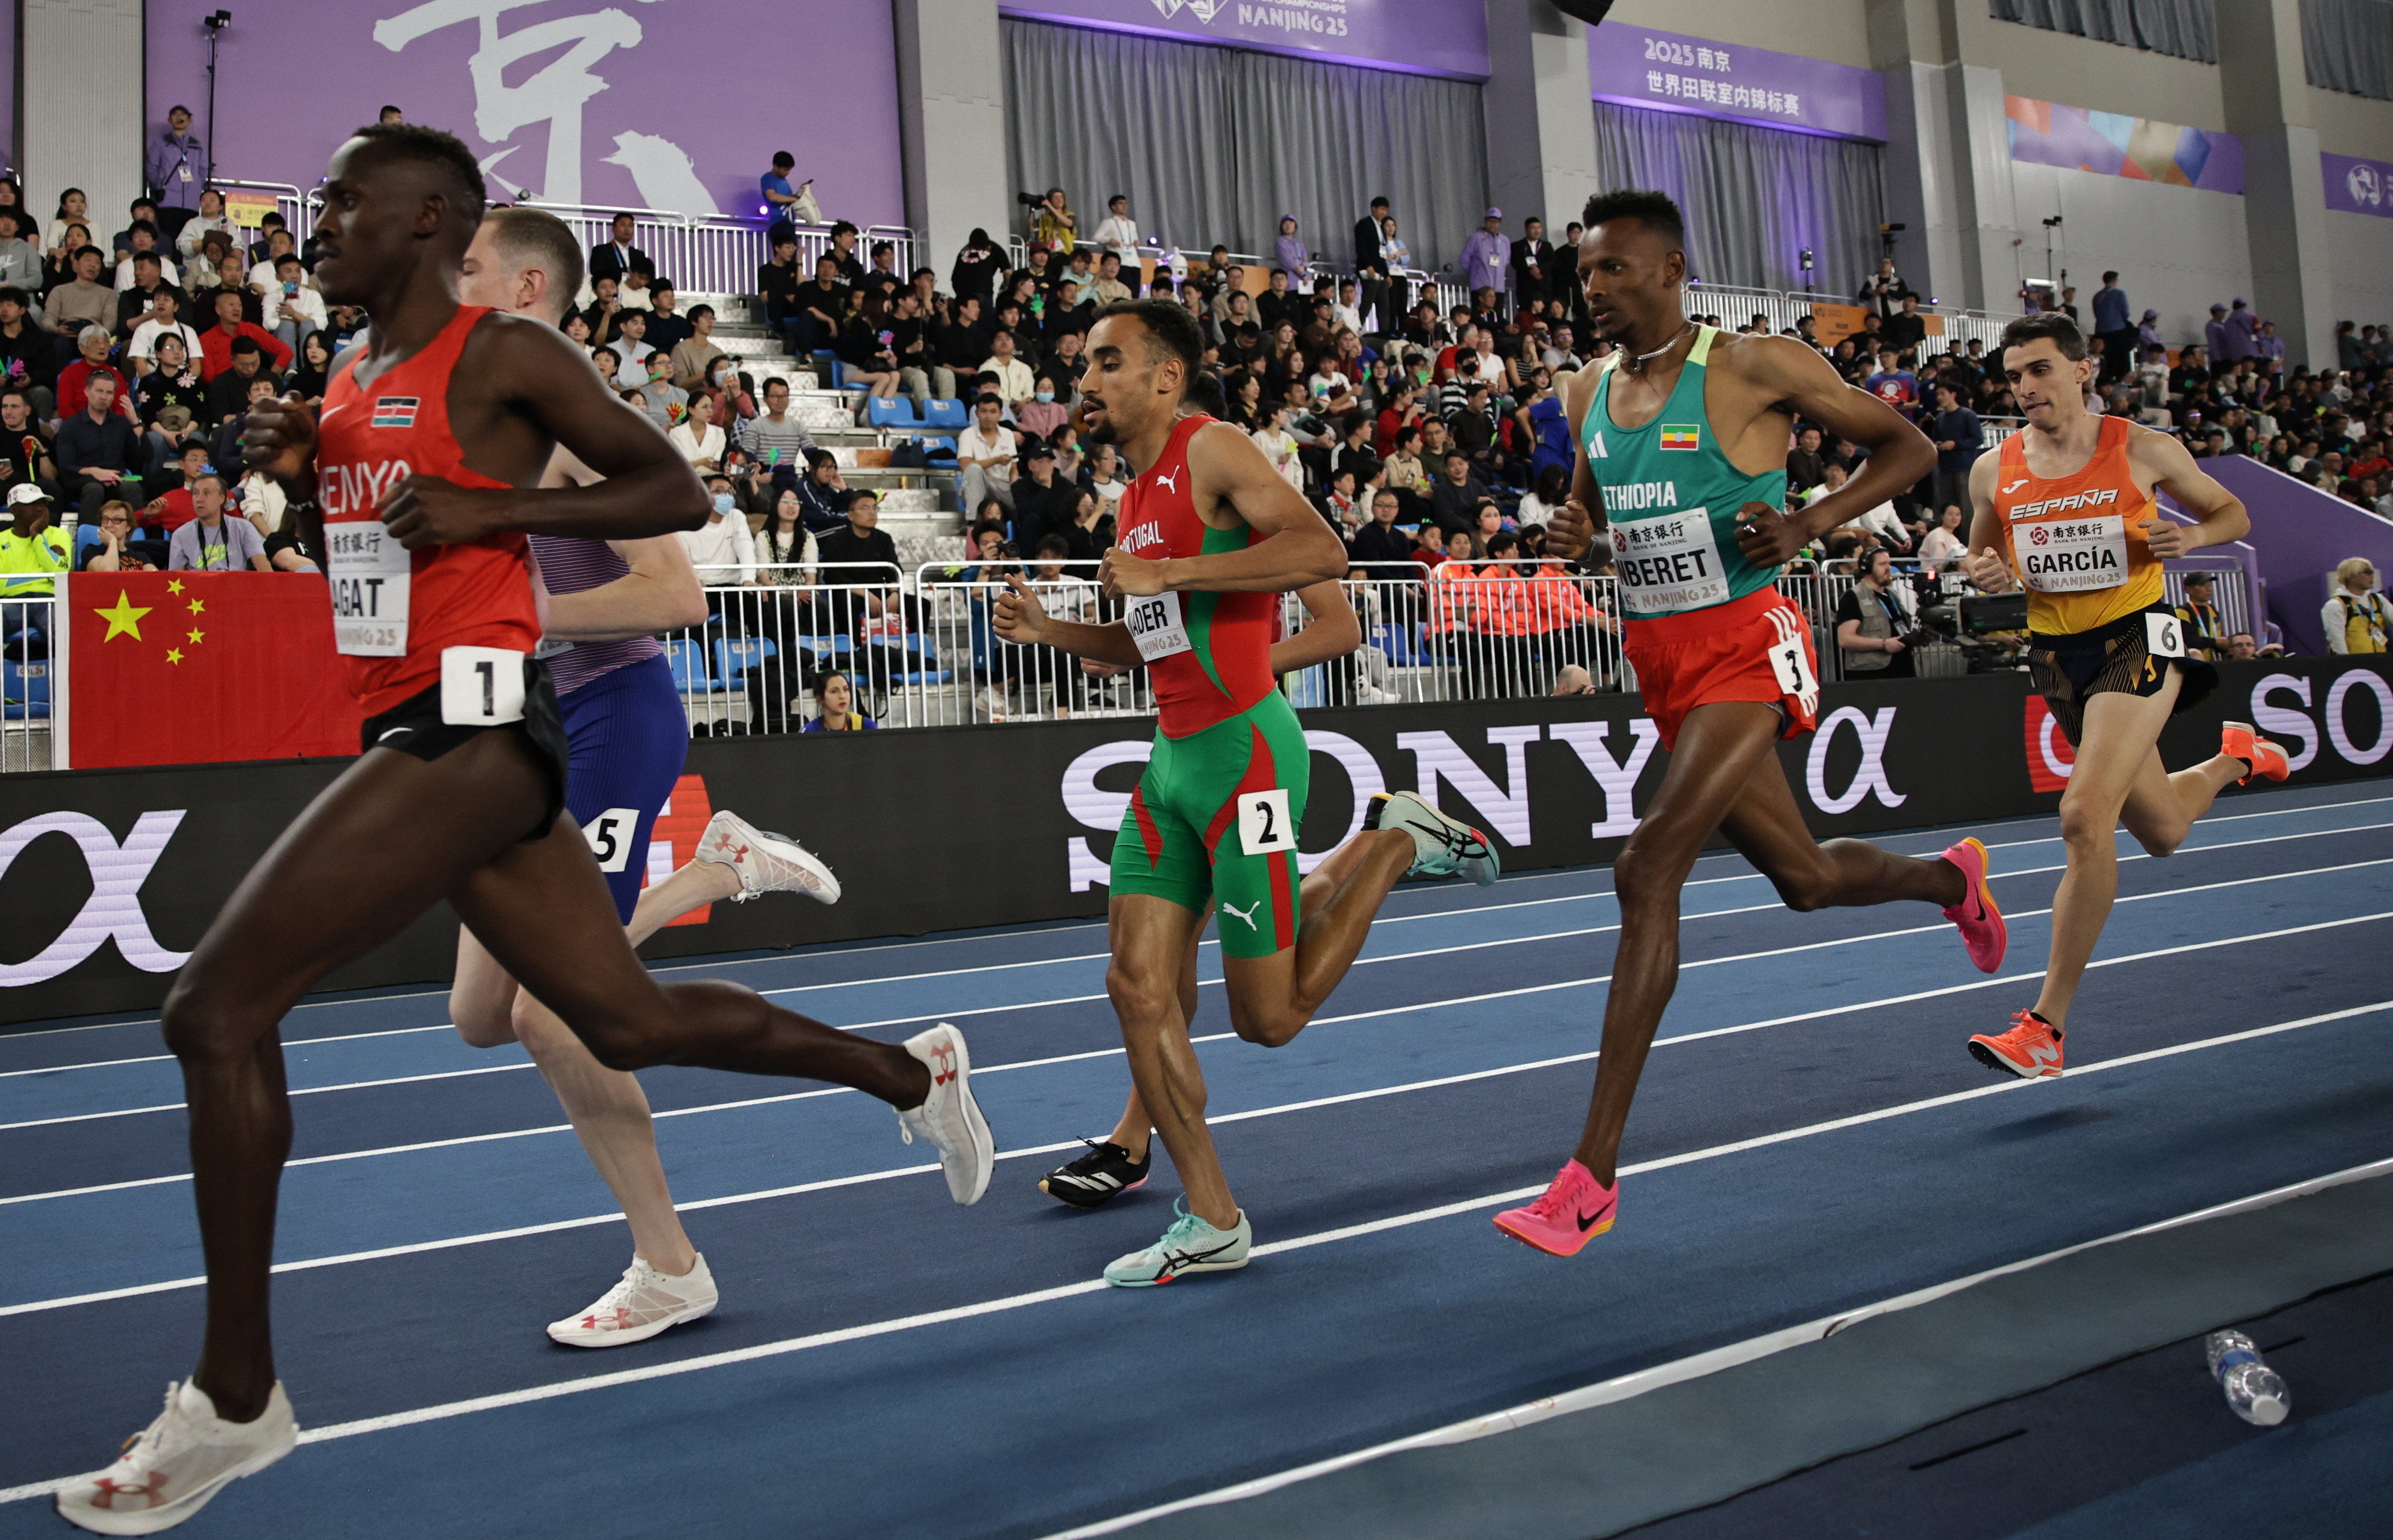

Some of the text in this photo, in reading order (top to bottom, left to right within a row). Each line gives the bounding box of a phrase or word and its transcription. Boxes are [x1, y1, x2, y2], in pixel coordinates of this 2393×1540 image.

[1238, 3, 1348, 36] NANJING 25
[1645, 38, 1731, 72] 2025 南京
[1646, 70, 1800, 116] 世界田联室内锦标赛
[319, 459, 412, 515] ENYA
[1602, 481, 1677, 511] ETHIOPIA
[2008, 488, 2120, 521] ESPAÑA
[1628, 521, 1685, 544] 南京银行
[1659, 538, 1688, 547] NANJING
[2053, 523, 2104, 538] 南京银行
[2027, 546, 2118, 574] GARCÍA
[1640, 584, 1720, 608] NANJING 25
[2050, 573, 2121, 589] NANJING 25
[376, 629, 397, 646] 25
[1167, 634, 1182, 648] 25
[2161, 621, 2176, 652] 6
[1785, 650, 1803, 692] 3
[475, 661, 495, 716] 1
[2250, 668, 2393, 772] SO
[1256, 801, 1278, 844] 2
[593, 818, 619, 863] 5
